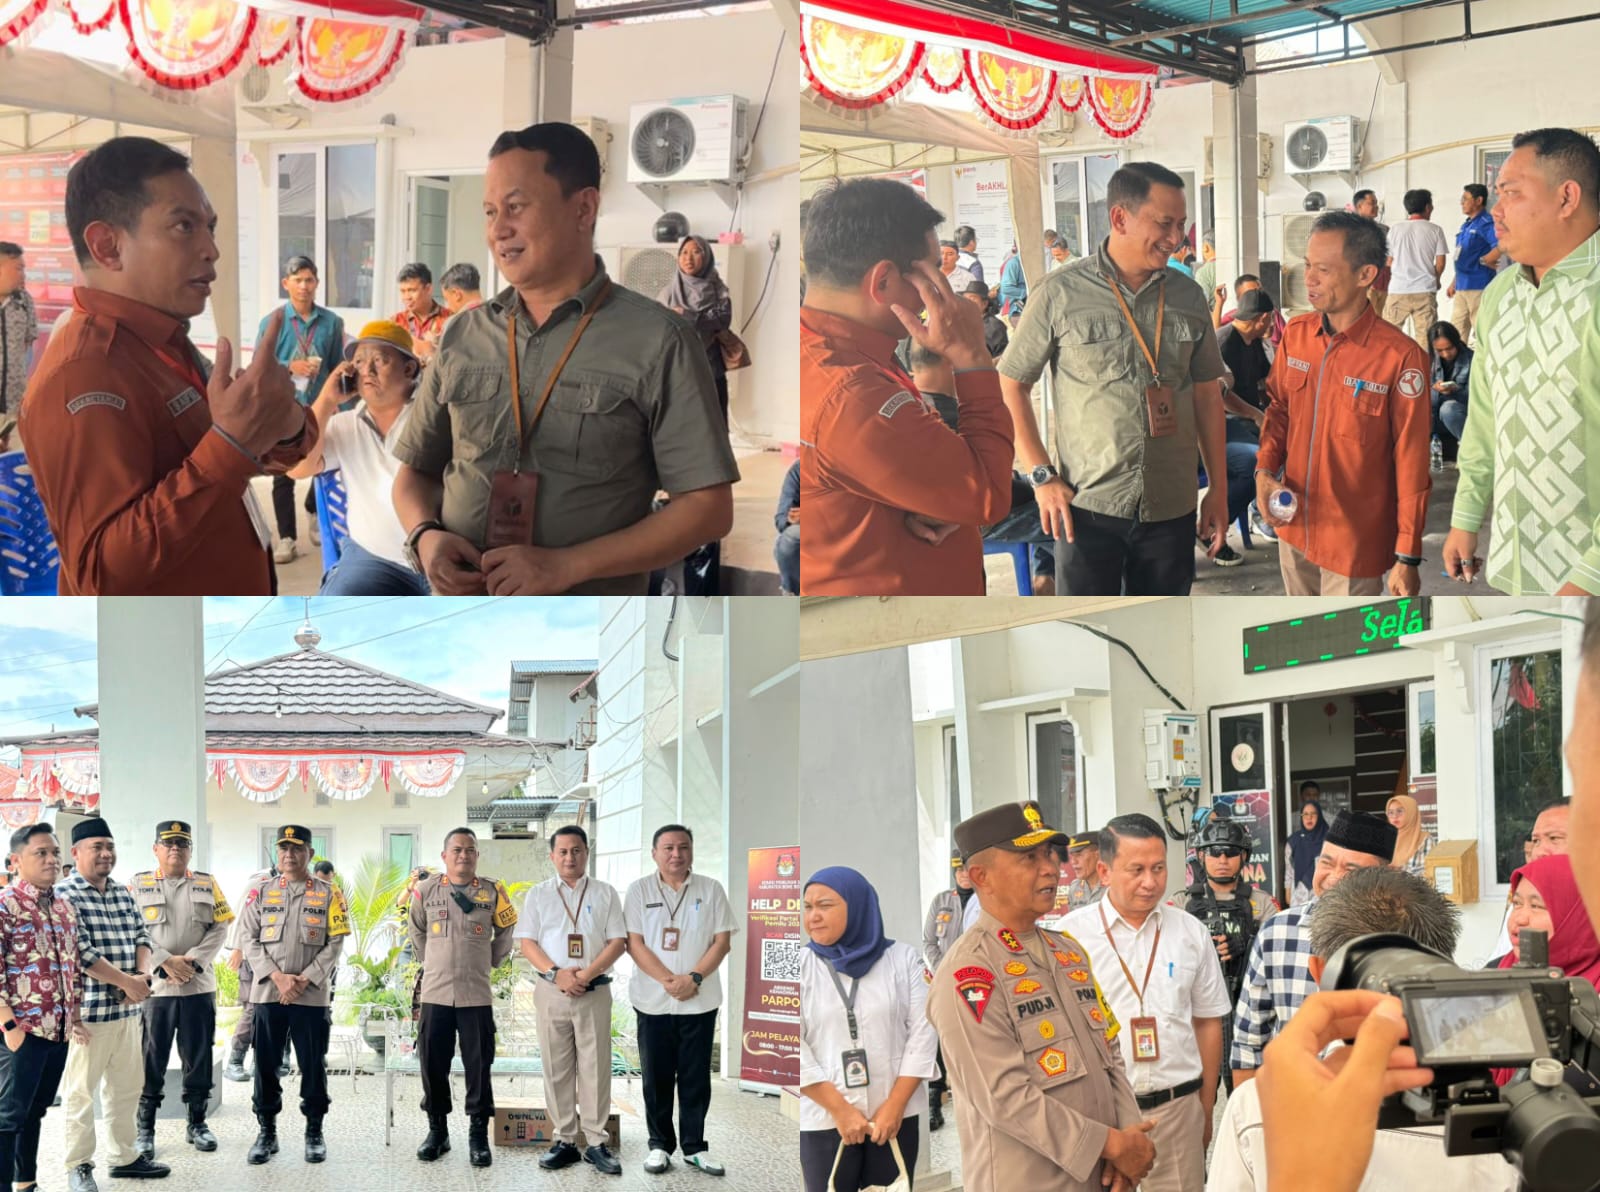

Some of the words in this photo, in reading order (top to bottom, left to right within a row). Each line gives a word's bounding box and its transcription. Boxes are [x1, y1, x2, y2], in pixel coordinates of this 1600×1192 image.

[976, 182, 1008, 191] BerAKHL
[751, 899, 781, 910] HELP
[303, 907, 326, 915] POLRI
[761, 995, 800, 1008] PARPO
[1017, 998, 1055, 1019] PUDJI
[751, 1031, 768, 1040] JAM
[769, 1032, 800, 1043] PELAYA
